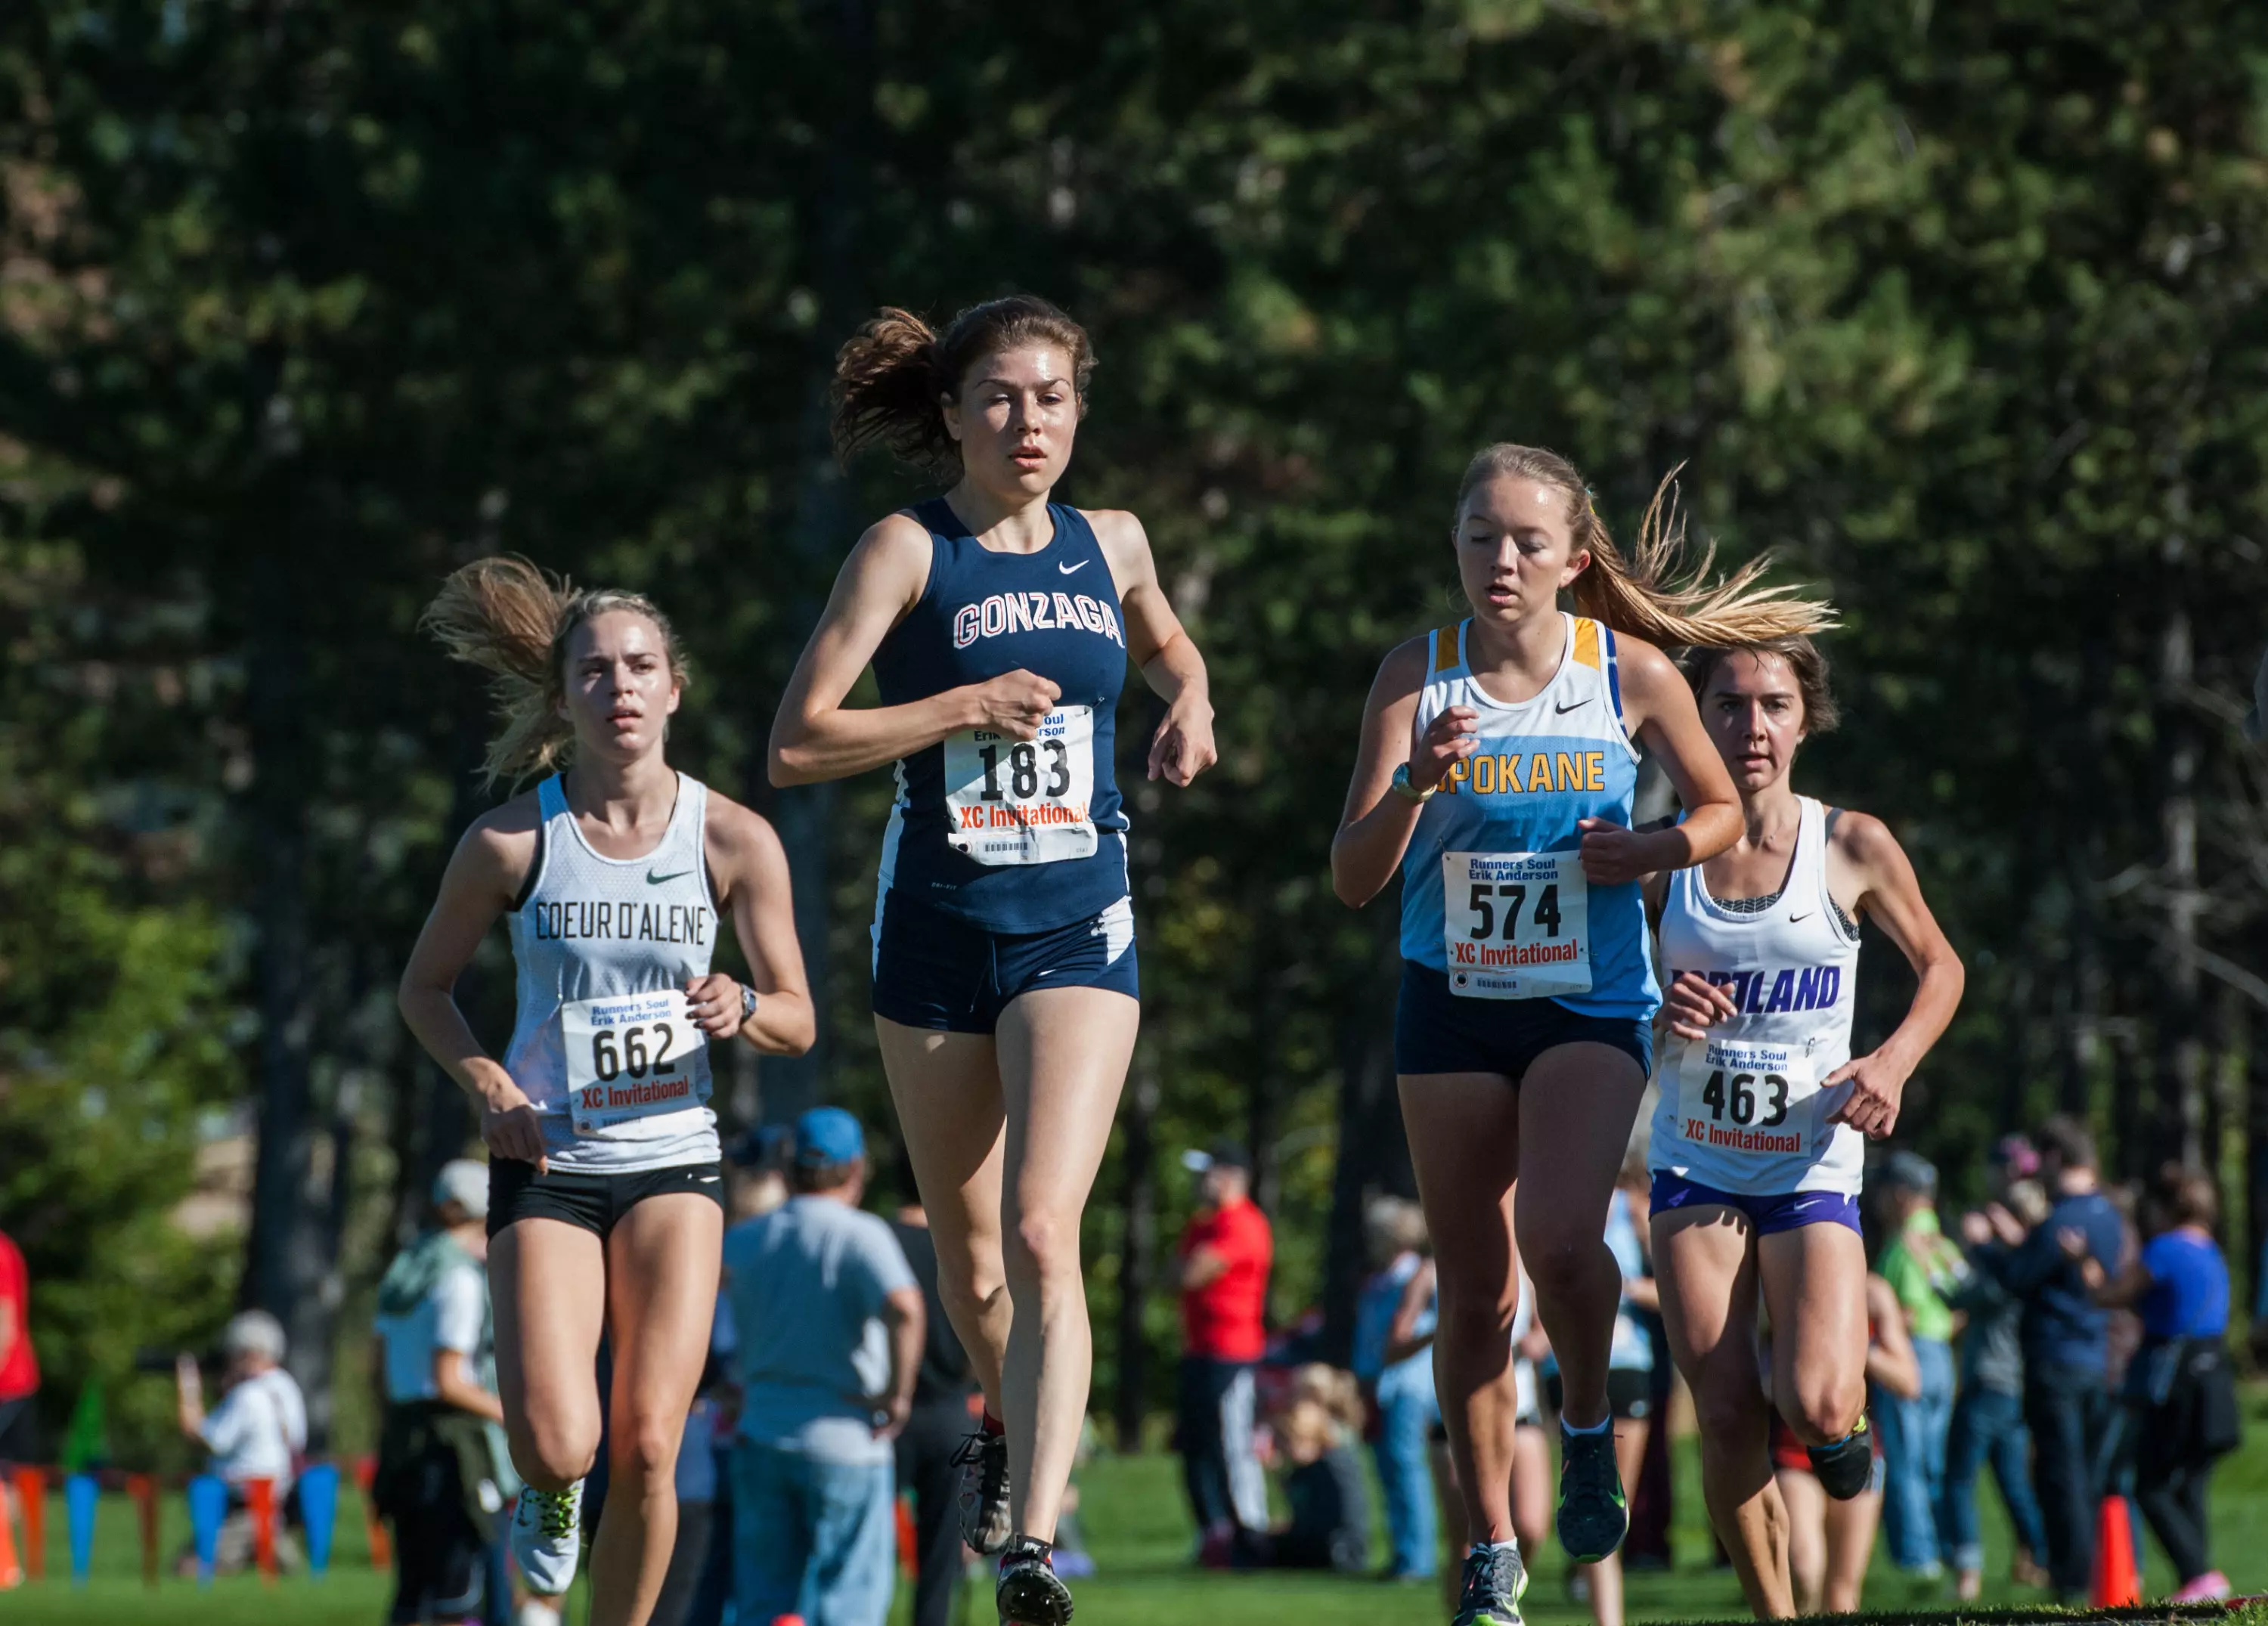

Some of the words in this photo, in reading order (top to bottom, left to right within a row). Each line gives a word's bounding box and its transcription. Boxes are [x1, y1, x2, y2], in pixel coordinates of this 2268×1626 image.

[953, 592, 1125, 649] GONZAGA
[1043, 713, 1064, 725] oul
[978, 739, 1071, 801] 183
[959, 806, 984, 828] XC
[990, 801, 1089, 827] Invitational
[1469, 869, 1492, 880] Erik
[1495, 870, 1559, 881] Anderson
[1470, 859, 1523, 869] Runners
[1527, 858, 1556, 869] Soul
[535, 902, 612, 940] COEUR
[618, 902, 707, 946] D'ALENE
[1469, 884, 1562, 940] 574
[1455, 942, 1476, 964] XC
[1480, 938, 1578, 965] Invitational
[1670, 966, 1841, 1014] TLAND
[591, 1015, 615, 1026] Erik
[620, 1010, 672, 1023] Anderson
[592, 1004, 642, 1015] Runners
[646, 999, 669, 1009] Soul
[592, 1022, 676, 1082] 662
[1706, 1053, 1725, 1067] Erik
[1730, 1058, 1788, 1070] Anderson
[1709, 1044, 1756, 1058] Runners
[1760, 1049, 1787, 1061] Soul
[581, 1089, 603, 1110] XC
[608, 1075, 689, 1107] Invitational
[1703, 1070, 1790, 1127] 463
[1685, 1118, 1705, 1141] XC
[1709, 1123, 1801, 1152] Invitational
